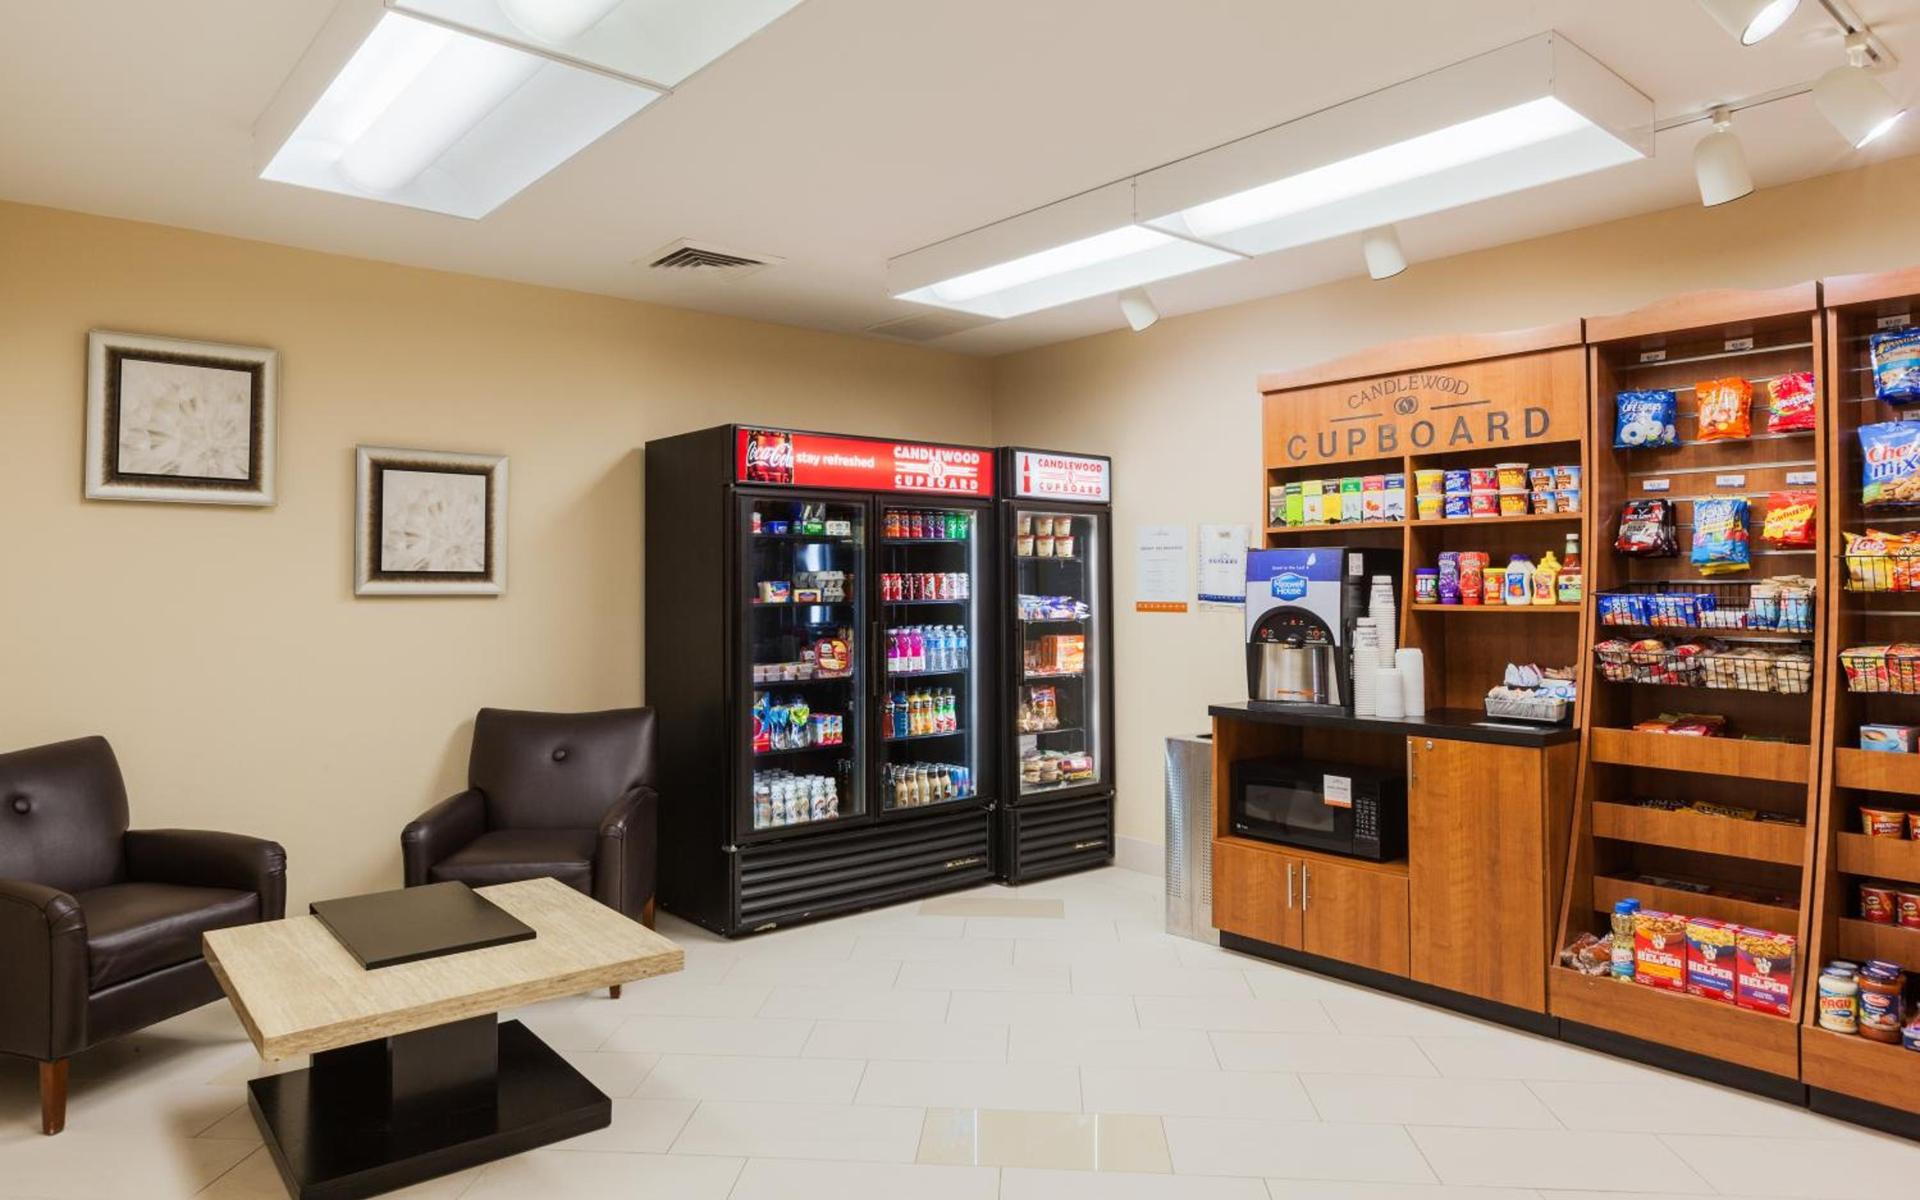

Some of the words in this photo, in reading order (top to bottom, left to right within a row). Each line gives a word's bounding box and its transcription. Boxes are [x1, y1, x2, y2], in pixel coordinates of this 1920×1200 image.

[1347, 374, 1470, 409] CANDLEWOOD
[1287, 407, 1550, 461] CUPBOARD
[795, 452, 820, 467] stay
[822, 453, 876, 469] refreshed
[894, 444, 980, 465] CANDLEWOOD
[1038, 457, 1103, 473] CANDLEWOOD
[894, 474, 979, 490] CUPBOARD
[1039, 481, 1102, 495] CUPBOARD
[1637, 949, 1682, 969] HELPER
[1688, 960, 1733, 980] HELPER
[1739, 974, 1789, 995] HELPER
